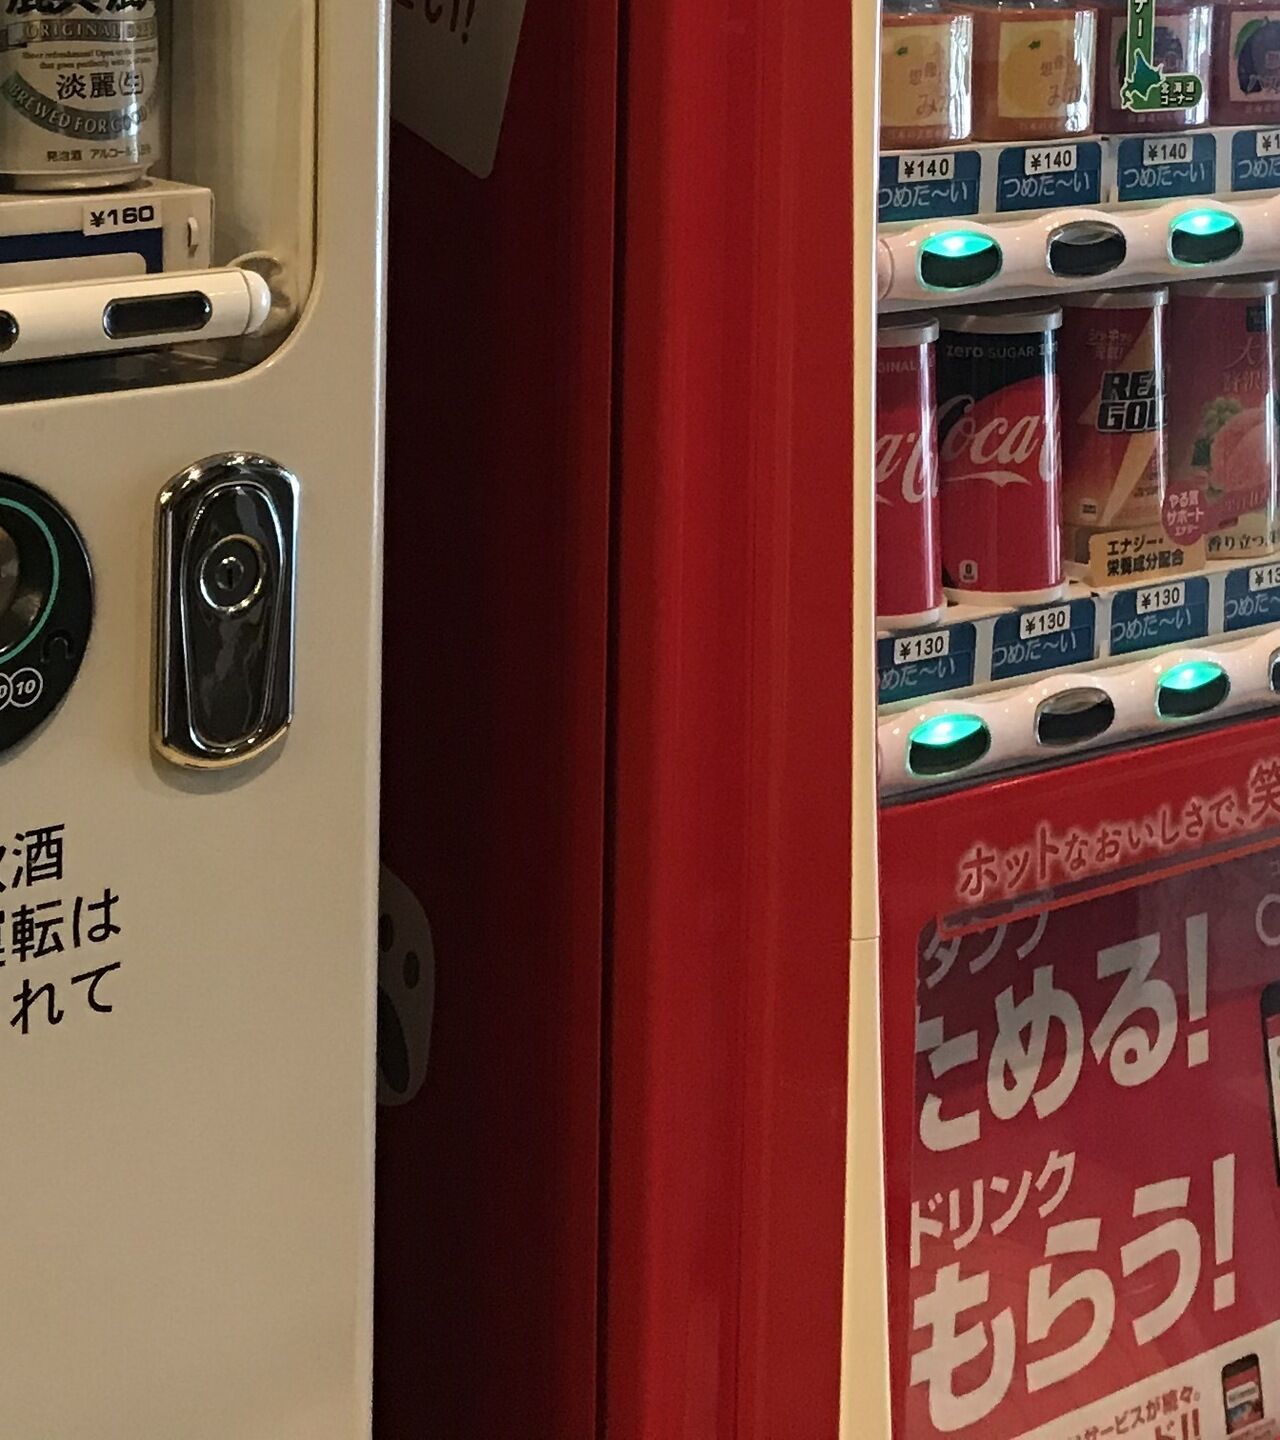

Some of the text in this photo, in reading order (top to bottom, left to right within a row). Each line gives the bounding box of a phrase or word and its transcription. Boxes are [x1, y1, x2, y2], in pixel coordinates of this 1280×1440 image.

[26, 20, 119, 39] ORIGINAL
[1161, 81, 1195, 93] 北海道
[10, 83, 107, 134] BREWED FOR
[1161, 94, 1193, 105] コーナー
[1030, 151, 1072, 170] ¥140
[1148, 142, 1187, 161] ¥140
[904, 160, 949, 178] ¥140
[90, 205, 155, 226] ¥160
[947, 345, 1035, 359] zero SUGAR
[1170, 490, 1200, 508] やる気
[1167, 509, 1204, 525] サポート
[1107, 548, 1184, 577] 栄養成分配合
[1141, 588, 1180, 608] ¥130
[1024, 611, 1066, 632] ¥130
[899, 636, 945, 657] ¥130
[16, 679, 36, 695] 10
[910, 1150, 1076, 1269] ドリンク
[910, 1154, 1236, 1433] もらう!
